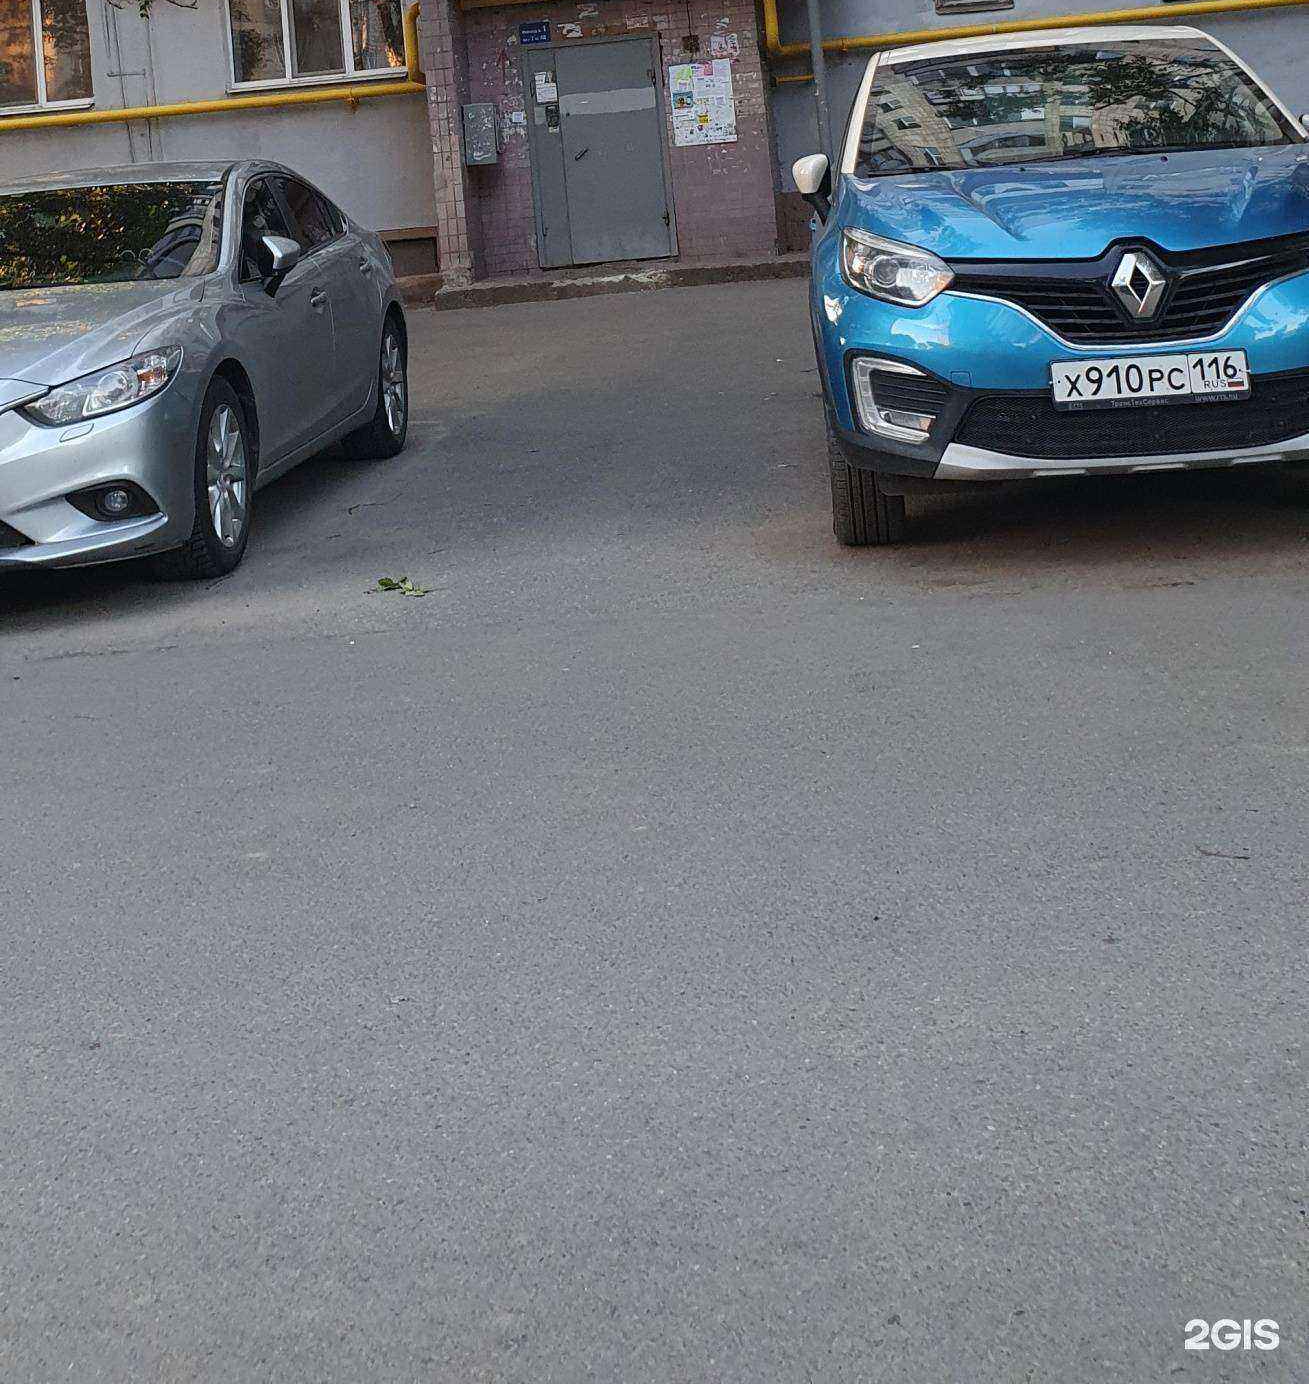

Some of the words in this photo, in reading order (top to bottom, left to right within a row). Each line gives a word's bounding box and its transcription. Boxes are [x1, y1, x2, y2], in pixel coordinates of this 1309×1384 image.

[1064, 363, 1186, 397] Х910РС
[1192, 356, 1238, 380] 116
[1203, 379, 1227, 390] RUS
